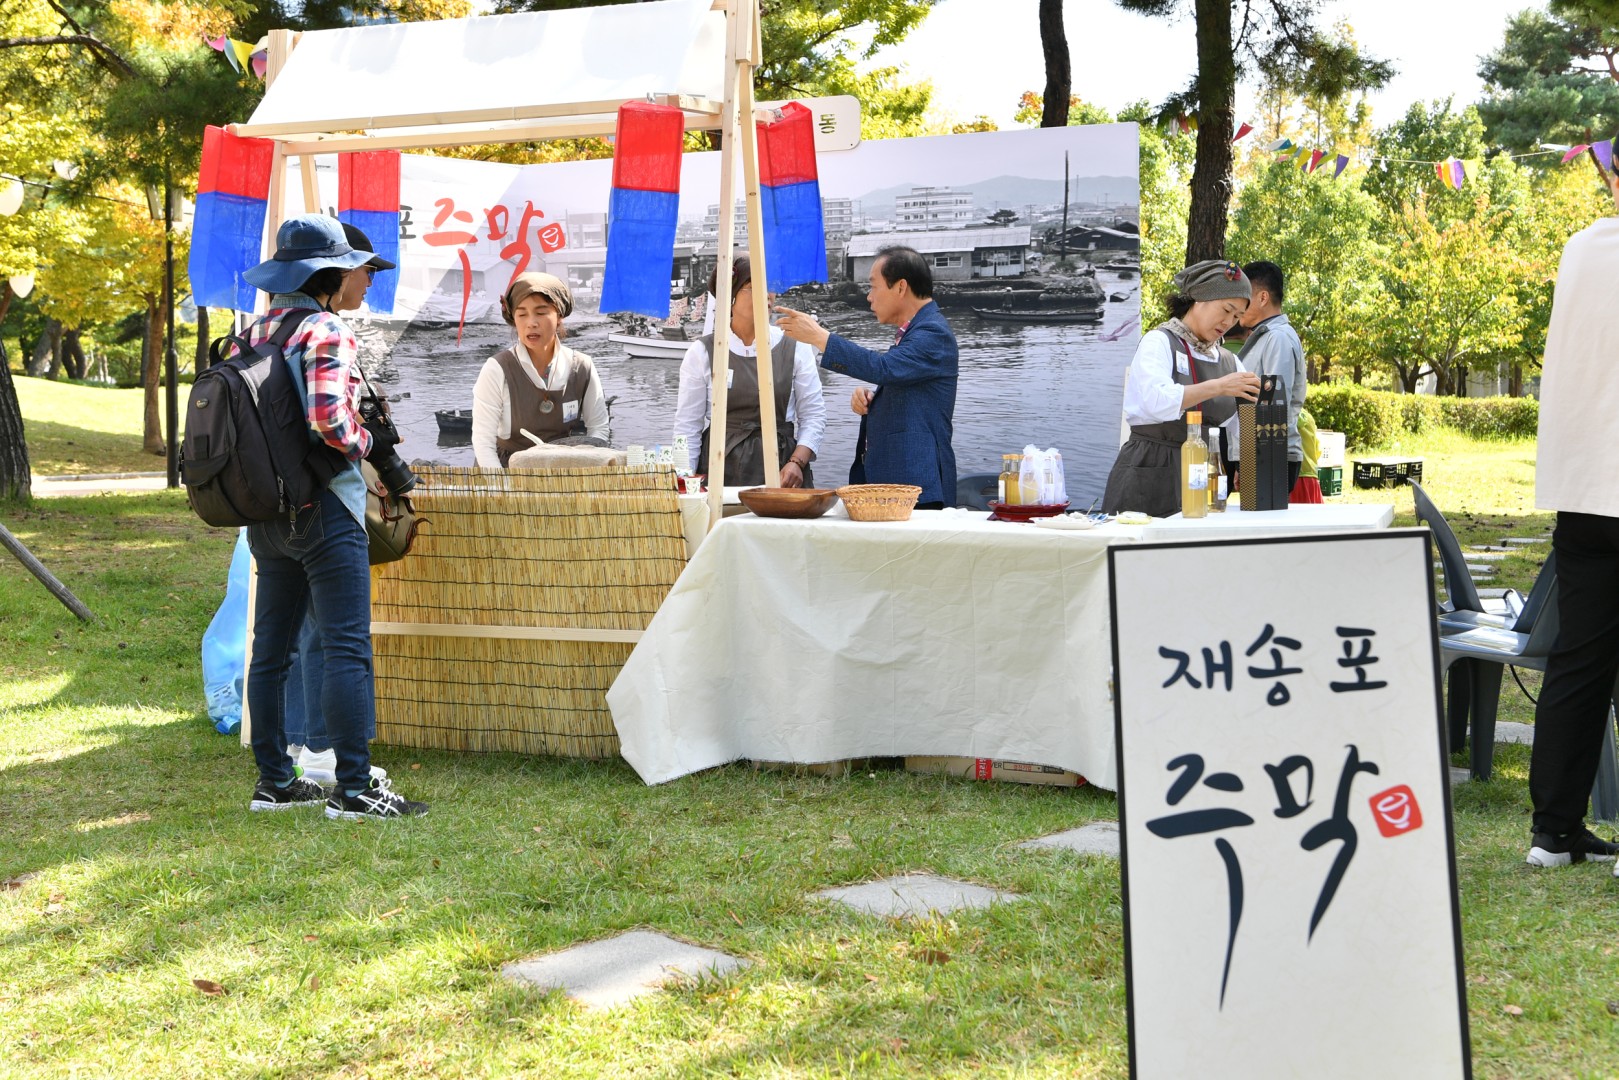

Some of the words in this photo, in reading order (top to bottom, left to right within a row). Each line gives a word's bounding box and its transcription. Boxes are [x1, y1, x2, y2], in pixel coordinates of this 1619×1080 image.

[423, 197, 545, 349] 주막
[1158, 623, 1388, 707] 재송포
[1145, 743, 1380, 1012] 주막
